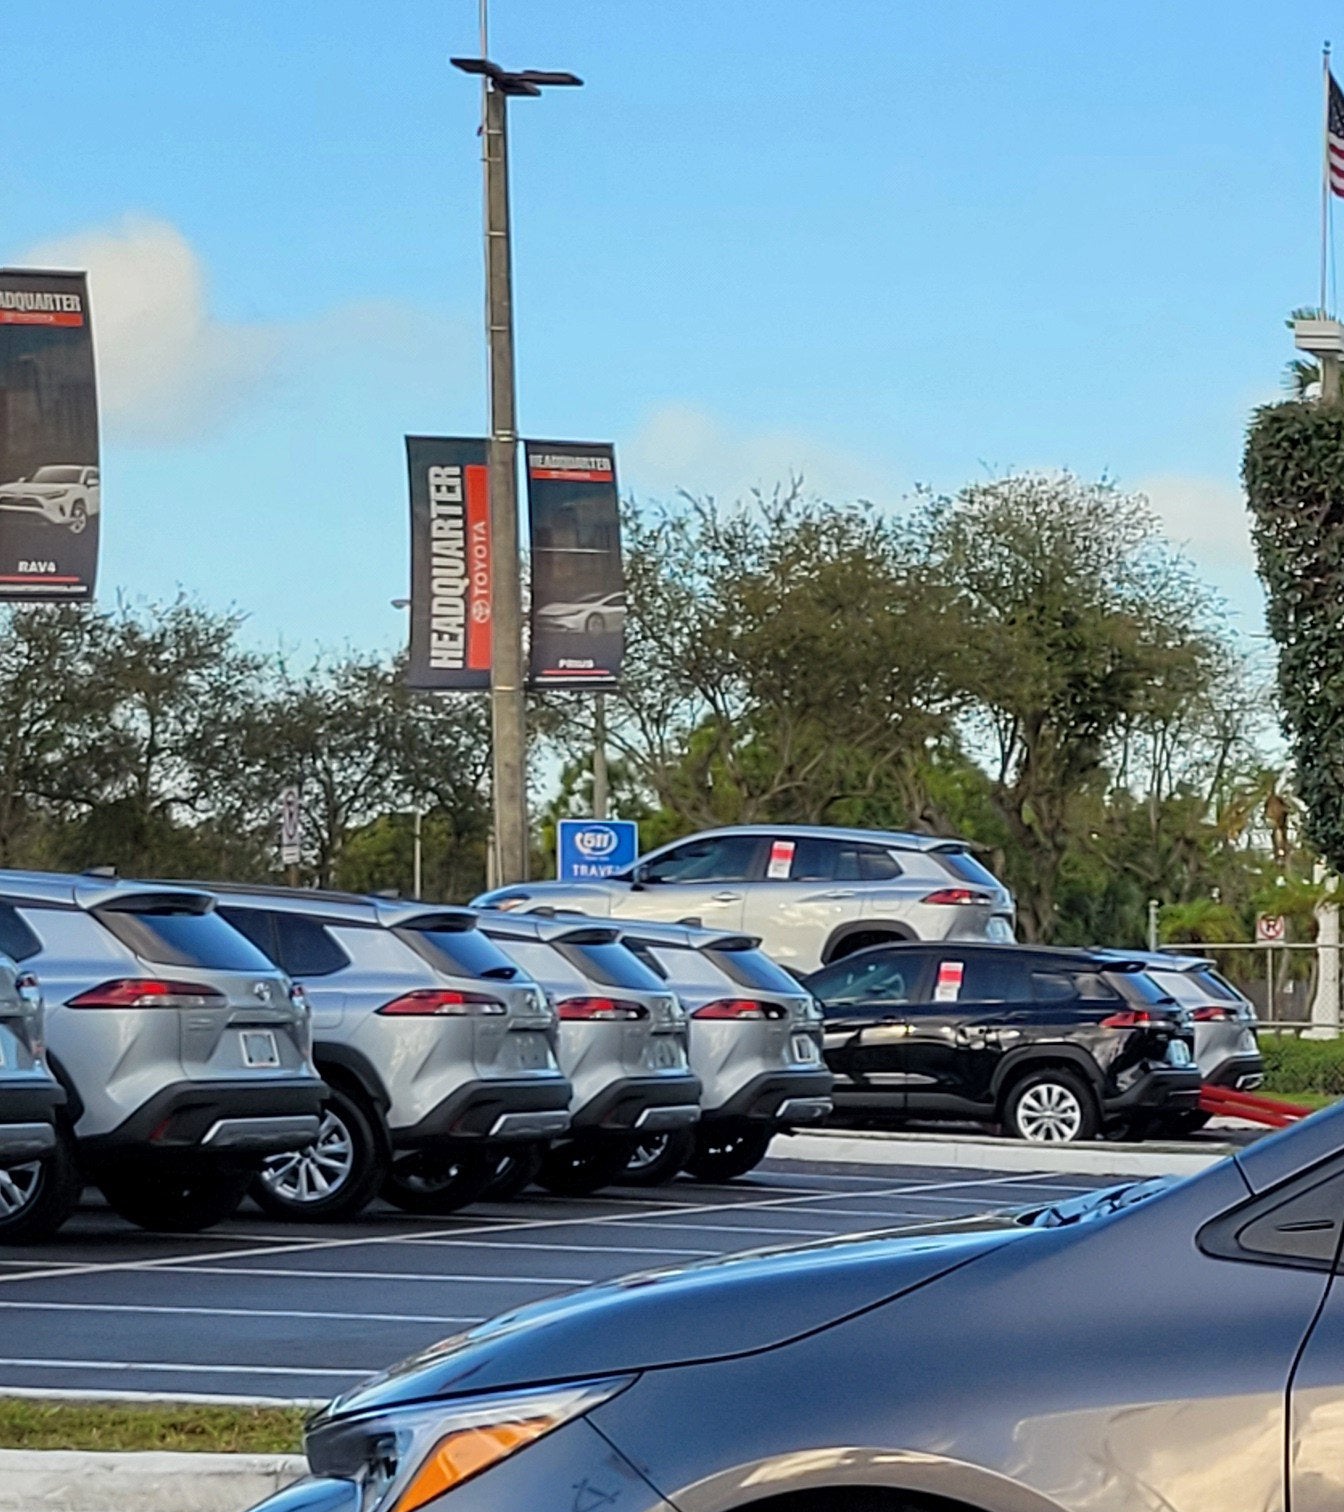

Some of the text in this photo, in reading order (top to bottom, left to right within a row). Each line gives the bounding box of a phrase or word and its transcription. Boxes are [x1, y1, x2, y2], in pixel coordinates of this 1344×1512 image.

[18, 561, 57, 573] RAV4
[428, 465, 469, 669] HEADQUARTER
[473, 521, 487, 596] TOYOTA
[583, 832, 610, 848] 511
